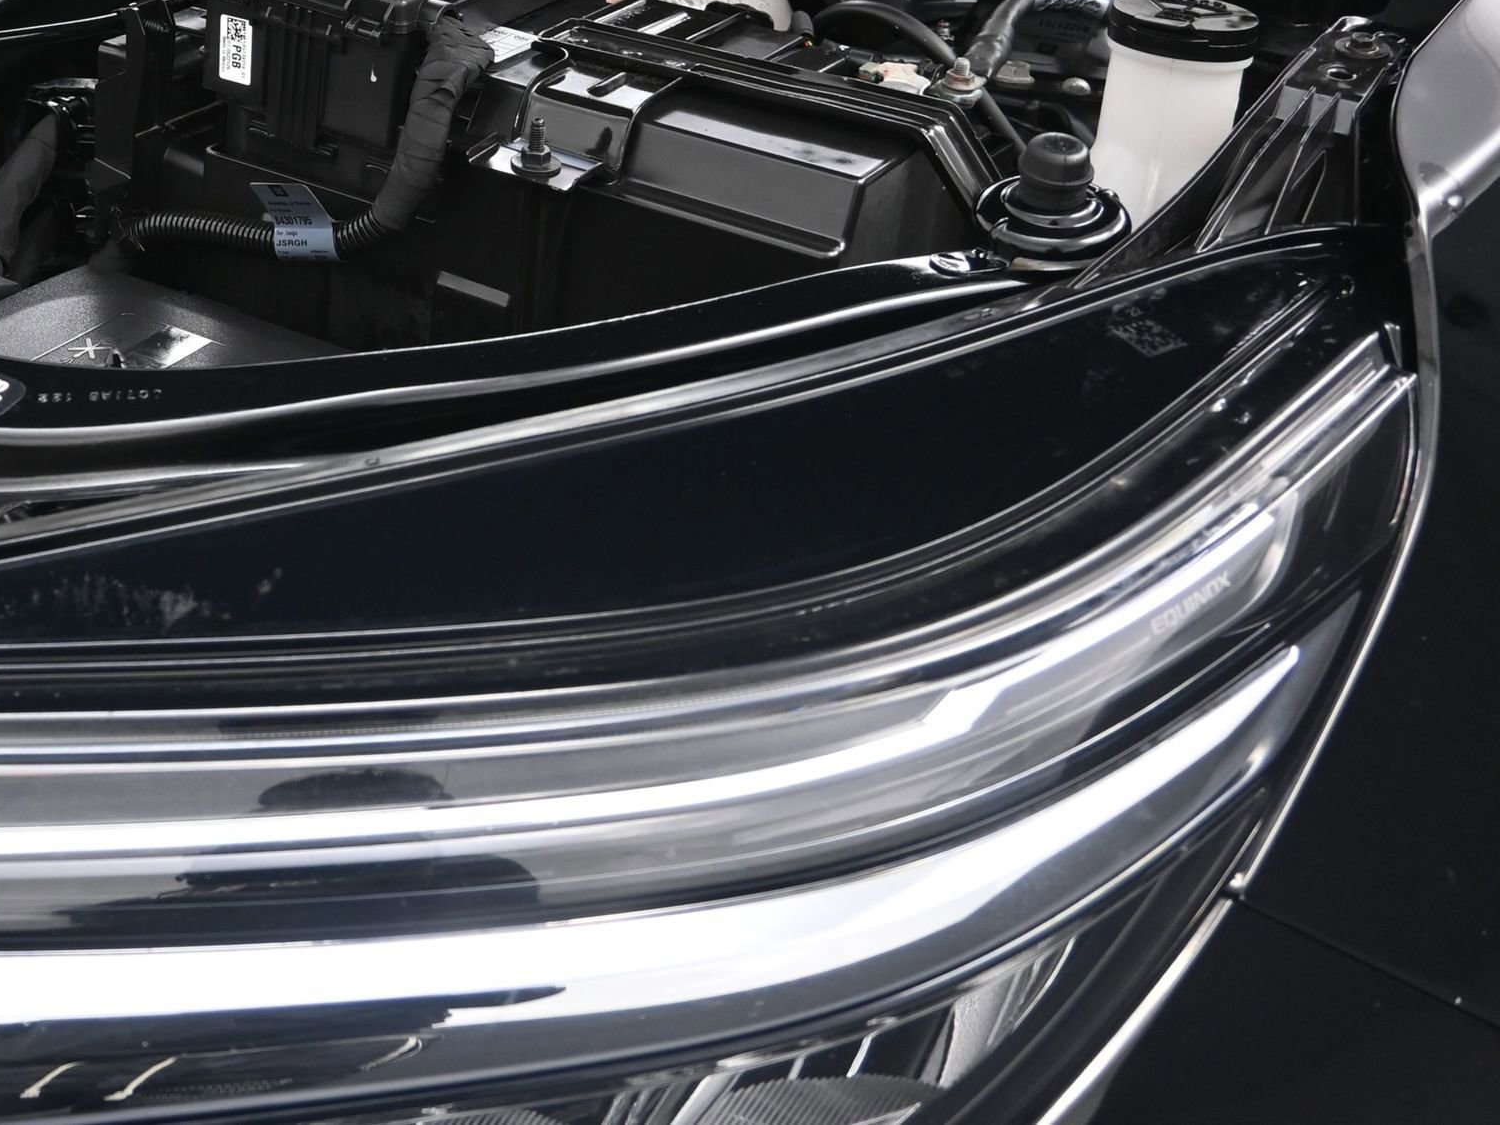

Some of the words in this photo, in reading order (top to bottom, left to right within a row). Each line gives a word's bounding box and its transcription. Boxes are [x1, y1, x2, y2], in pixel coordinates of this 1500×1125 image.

[231, 44, 242, 69] PGB
[275, 216, 312, 225] 84301795
[276, 239, 308, 247] JSRGH
[1150, 571, 1232, 635] EQUINOX
